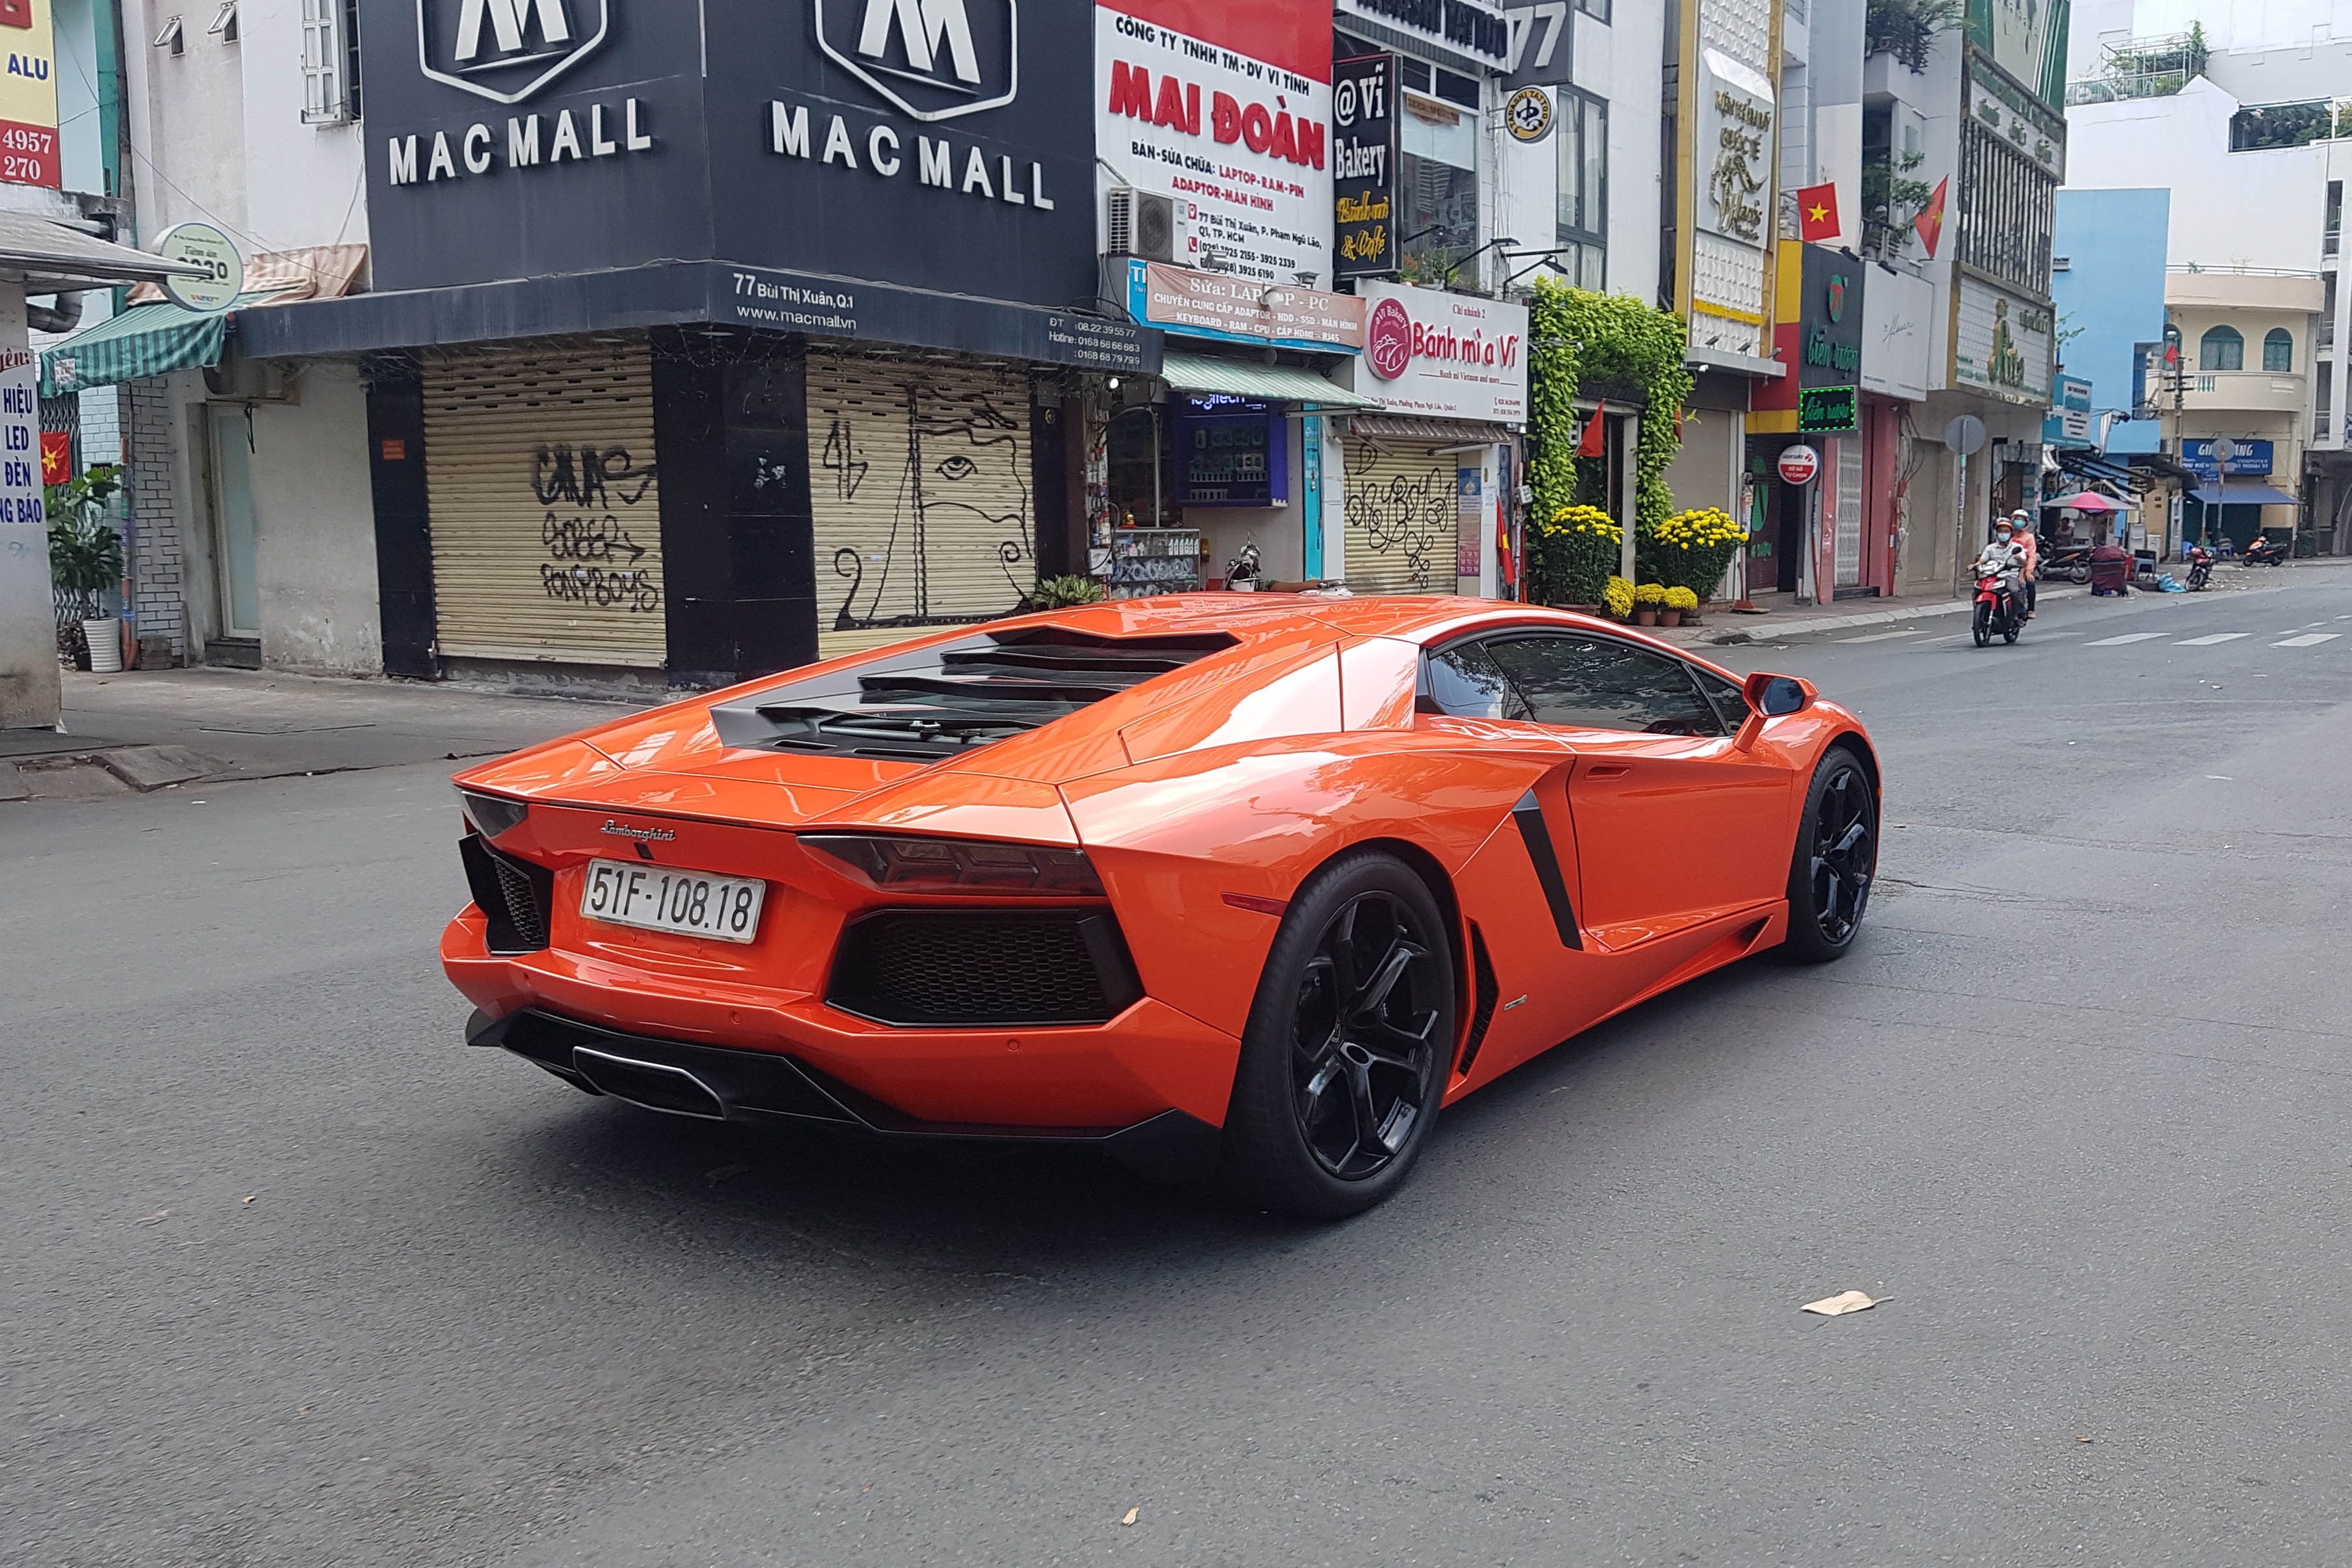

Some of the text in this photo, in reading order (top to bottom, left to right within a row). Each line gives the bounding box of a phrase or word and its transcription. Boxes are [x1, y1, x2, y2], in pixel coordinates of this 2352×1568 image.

[7, 53, 48, 80] ALU
[1116, 16, 1155, 43] CÔNG
[1161, 31, 1177, 50] TY
[1183, 40, 1217, 64] TNHH
[1267, 68, 1279, 86] VI
[1284, 74, 1309, 96] TÍNH
[1109, 60, 1325, 170] MAI ĐOÀN
[2, 128, 52, 154] 4957
[3, 155, 41, 180] 270
[1335, 137, 1385, 187] Bakery
[1199, 212, 1208, 223] 77
[1262, 226, 1268, 236] P.
[1271, 228, 1290, 241] Phạm
[1213, 229, 1225, 239] TP.
[1227, 231, 1245, 243] HCM
[1239, 265, 1256, 276] 3925
[1258, 268, 1274, 279] 6190
[1261, 254, 1277, 265] 3925
[1279, 258, 1295, 268] 2339
[733, 273, 756, 295] 77
[757, 283, 778, 299] Bùi
[780, 286, 800, 304] Thị
[1190, 278, 1225, 296] Sửa:
[1309, 296, 1329, 311] PC
[1176, 312, 1222, 327] KEYBOARD
[1229, 321, 1247, 331] RAM
[1254, 324, 1270, 334] CPU
[1277, 325, 1292, 336] CÁP
[1192, 299, 1215, 311] CUNG
[1235, 307, 1270, 319] ADAPTOR
[1278, 313, 1294, 322] HDD
[1301, 316, 1316, 325] SSD
[1322, 317, 1338, 328] MÀN
[1453, 304, 1463, 315] Chi
[1482, 309, 1486, 318] 2
[1049, 318, 1064, 327] ĐT
[1103, 326, 1113, 334] 39
[1115, 328, 1124, 336] 55
[1126, 329, 1136, 338] 77
[1078, 336, 1098, 347] 0168
[1100, 340, 1111, 349] 66
[1111, 342, 1122, 350] 66
[1413, 321, 1519, 368] Bánh mì a Vĩ
[1460, 372, 1479, 382] Vietnam
[3, 383, 33, 419] HIỆU
[6, 426, 29, 451] LED
[5, 456, 32, 487] ĐÈN
[16, 494, 42, 523] BÁO
[601, 819, 675, 841] Lamborghini
